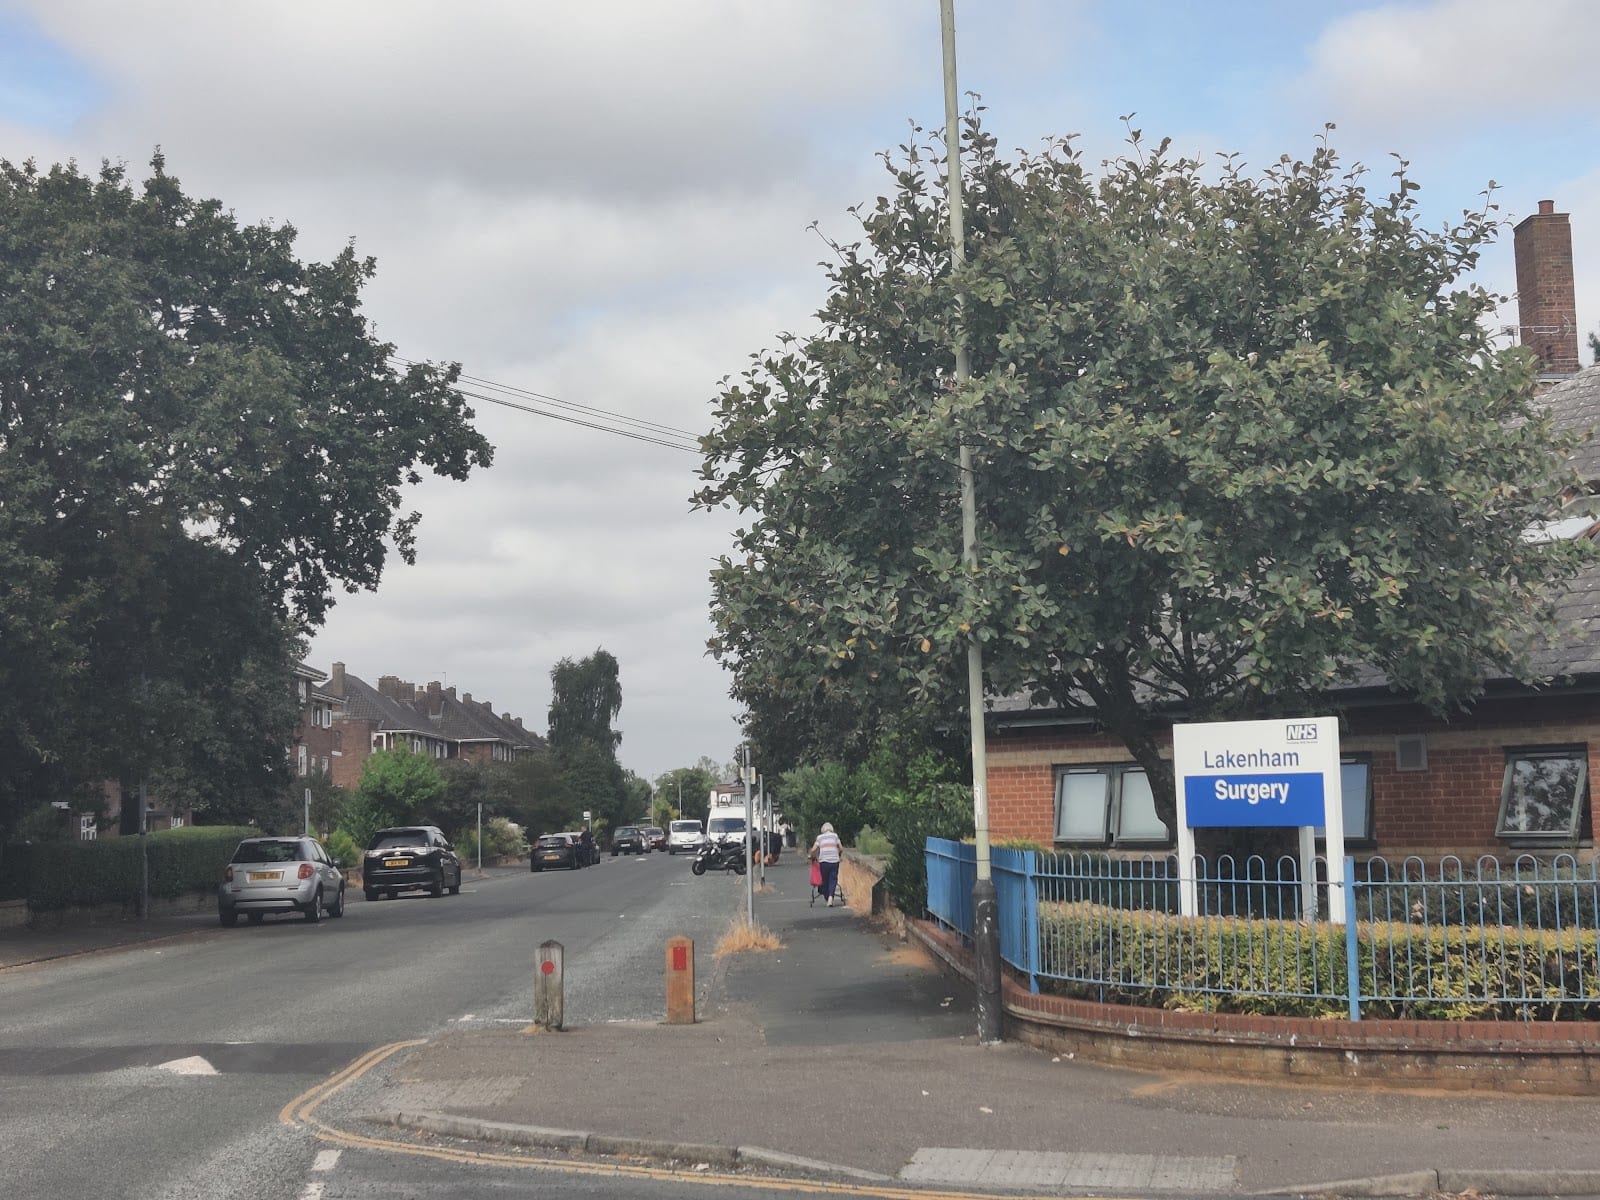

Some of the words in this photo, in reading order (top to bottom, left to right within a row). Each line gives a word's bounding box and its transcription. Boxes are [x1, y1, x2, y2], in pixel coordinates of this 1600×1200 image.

[1287, 724, 1317, 740] NHS
[1204, 749, 1299, 769] Lakenham
[1215, 779, 1290, 805] Surgery
